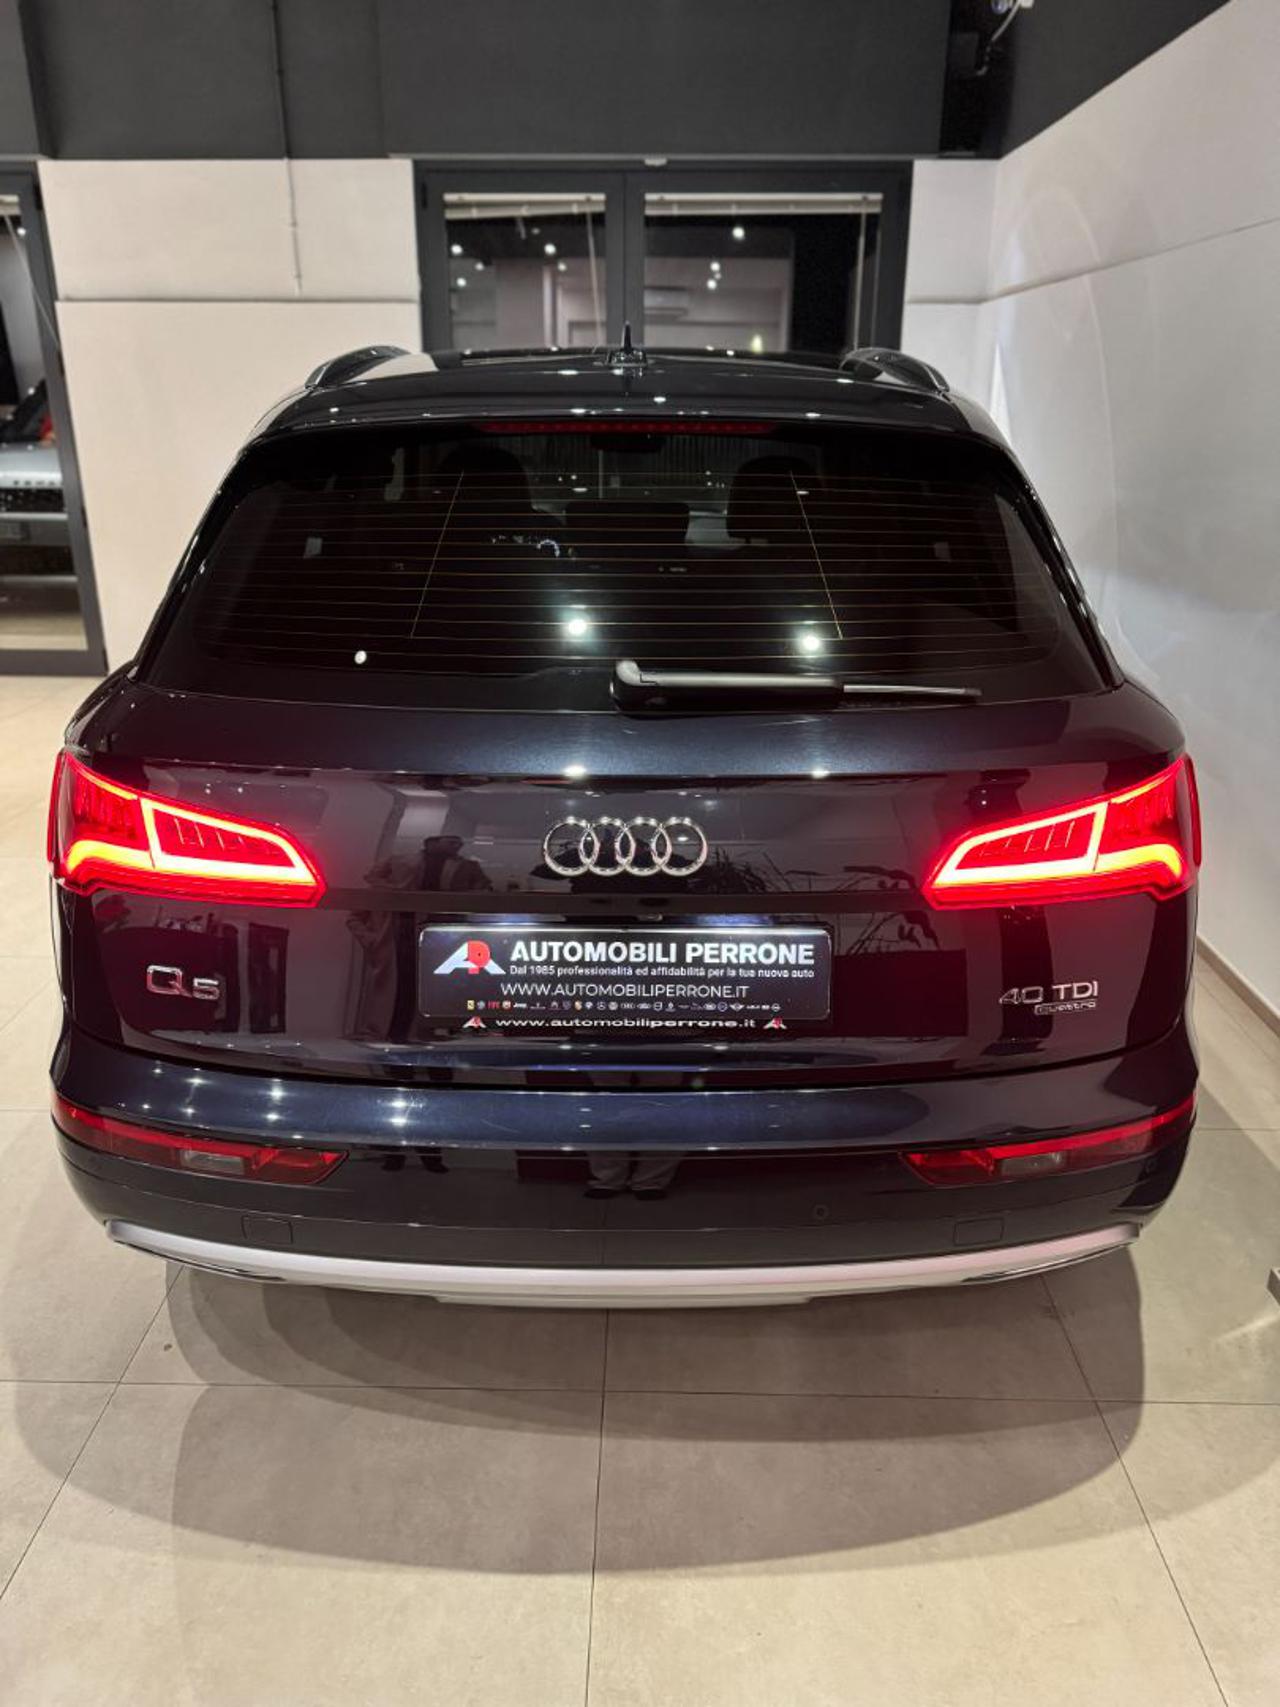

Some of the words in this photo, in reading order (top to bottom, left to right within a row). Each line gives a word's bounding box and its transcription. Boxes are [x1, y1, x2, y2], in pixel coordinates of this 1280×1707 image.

[510, 940, 677, 963] AUTOMOBILI
[685, 942, 815, 965] PERRONE
[146, 964, 220, 1000] Q5
[509, 965, 527, 975] Dal
[530, 965, 555, 976] 1985
[557, 965, 633, 978] professionalità
[635, 966, 649, 976] ed
[707, 968, 725, 979] per
[726, 967, 737, 977] la
[739, 969, 756, 978] tua
[758, 969, 790, 979] nuova
[791, 970, 815, 979] auto
[501, 983, 749, 998] WWW.AUTOMOBILIPERRONE.IT
[998, 985, 1044, 1005] 40
[1051, 980, 1099, 1000] TDI
[495, 1018, 756, 1028] www.automobiliperrone.it
